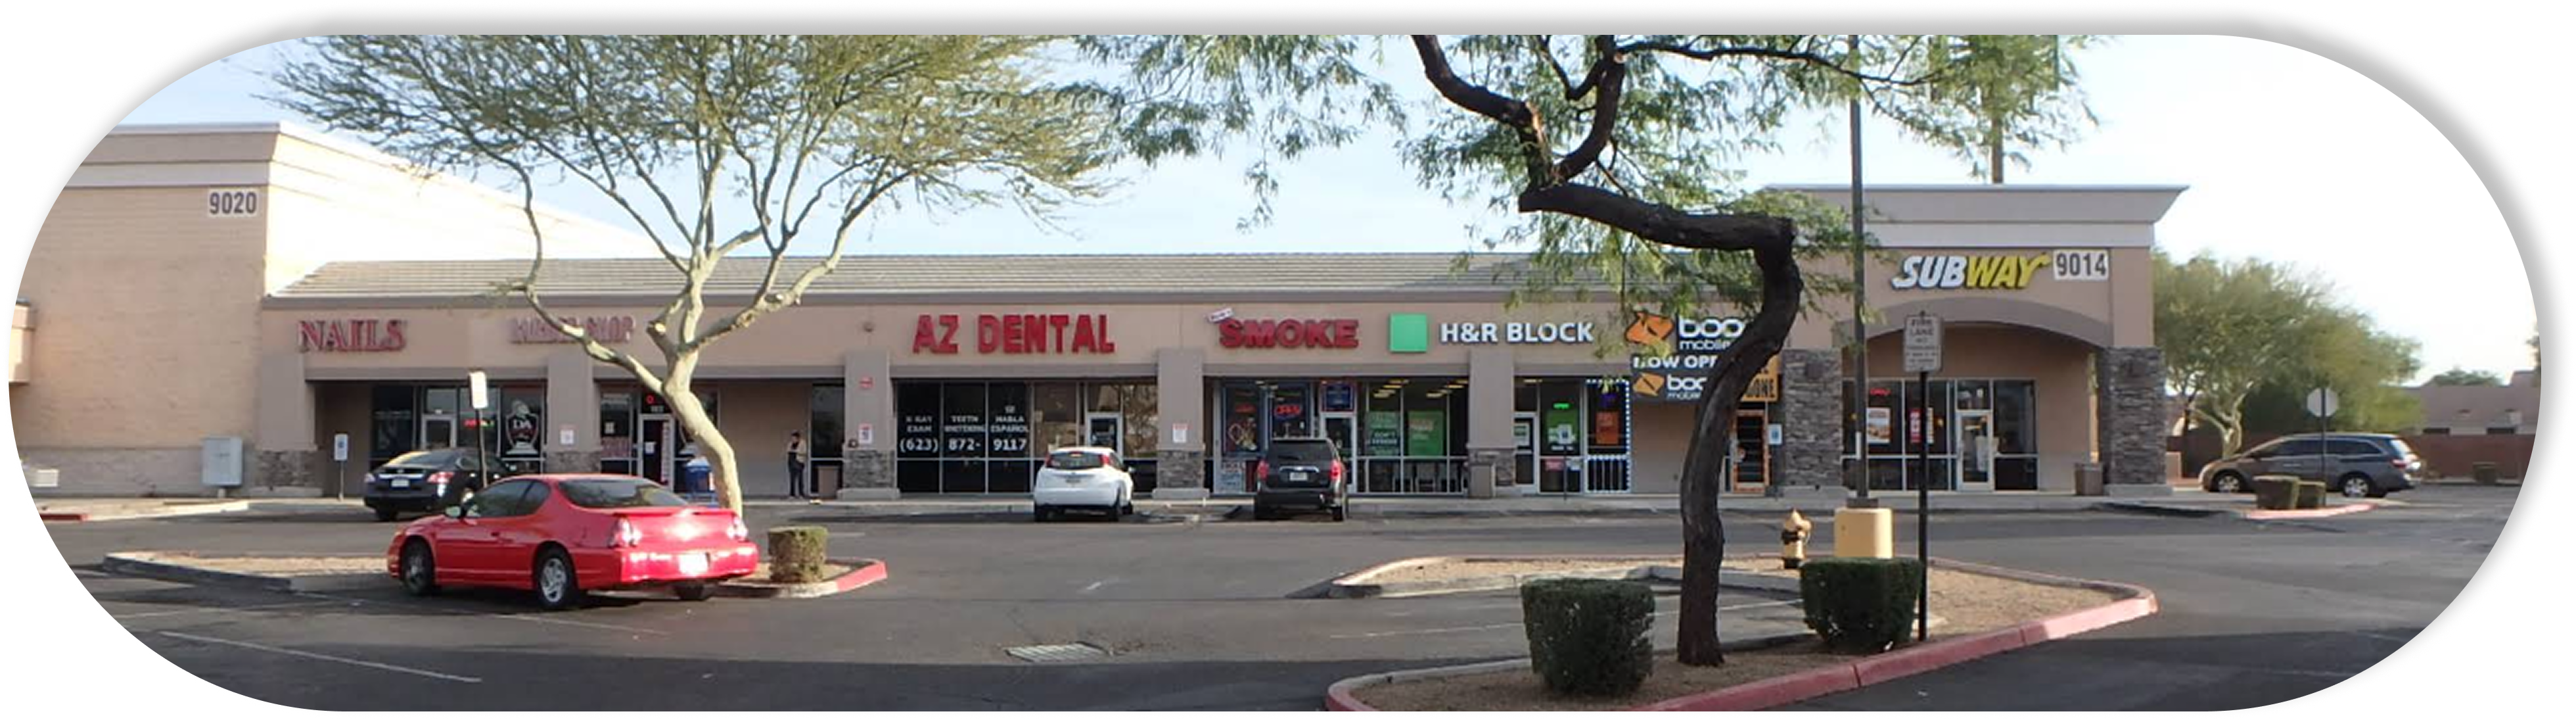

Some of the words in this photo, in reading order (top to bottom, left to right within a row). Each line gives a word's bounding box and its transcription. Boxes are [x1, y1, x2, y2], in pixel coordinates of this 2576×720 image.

[209, 191, 257, 214] 9020
[1892, 254, 2052, 289] SUBWAY
[2056, 253, 2106, 276] 9014
[300, 320, 407, 352] NAILS
[912, 314, 959, 354] AZ
[977, 314, 1115, 354] DENTAL
[1219, 319, 1359, 348] SMOKE
[1440, 322, 1498, 344] H&R
[1506, 322, 1595, 343] BLOCK
[1678, 316, 1746, 339] boo
[900, 437, 939, 453] (623)
[948, 438, 981, 451] 872-
[993, 438, 1027, 451] 9117
